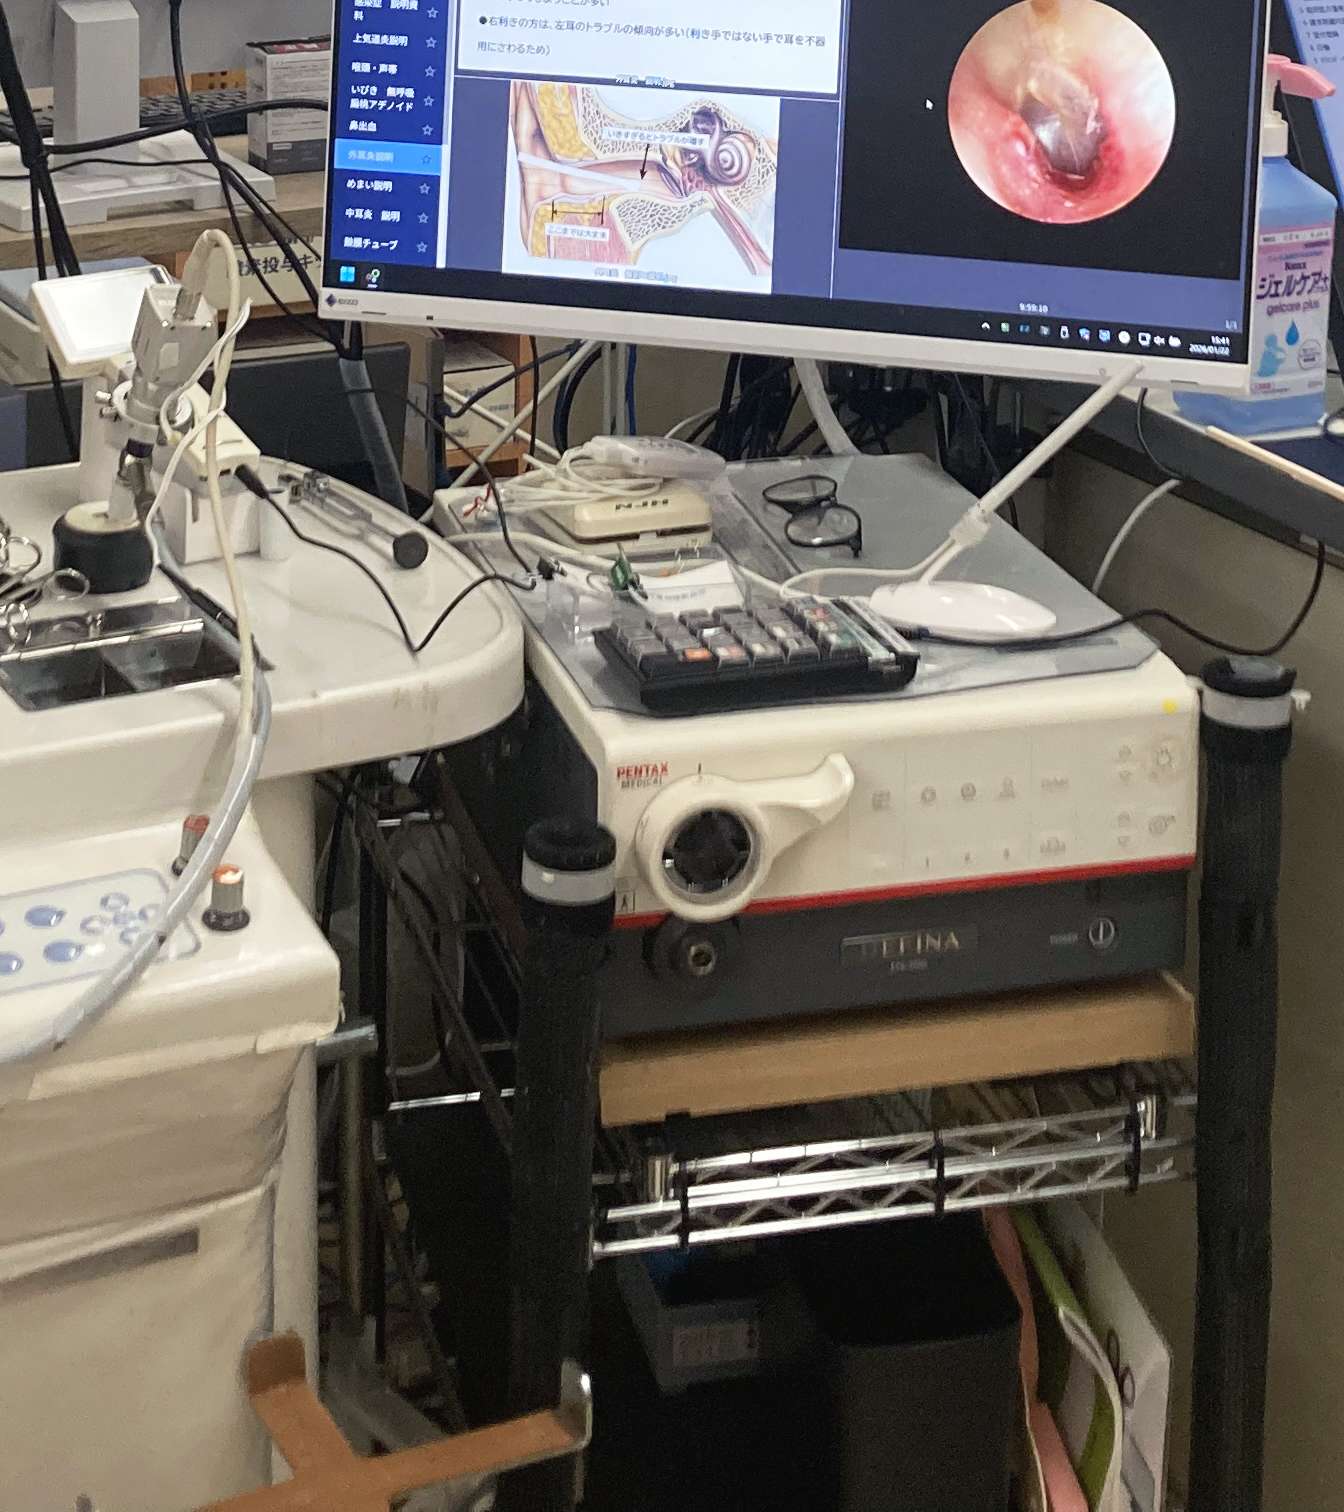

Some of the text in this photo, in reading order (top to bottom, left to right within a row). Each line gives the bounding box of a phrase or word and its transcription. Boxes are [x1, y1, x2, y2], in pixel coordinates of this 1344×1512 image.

[353, 33, 408, 47] 上気道炎説明
[477, 40, 551, 55] 用にさわるため)
[351, 85, 378, 96] いびき
[346, 179, 393, 192] めまい説明
[381, 210, 401, 223] 説明
[616, 763, 669, 780] PENTAX
[621, 777, 664, 790] MEDICAL
